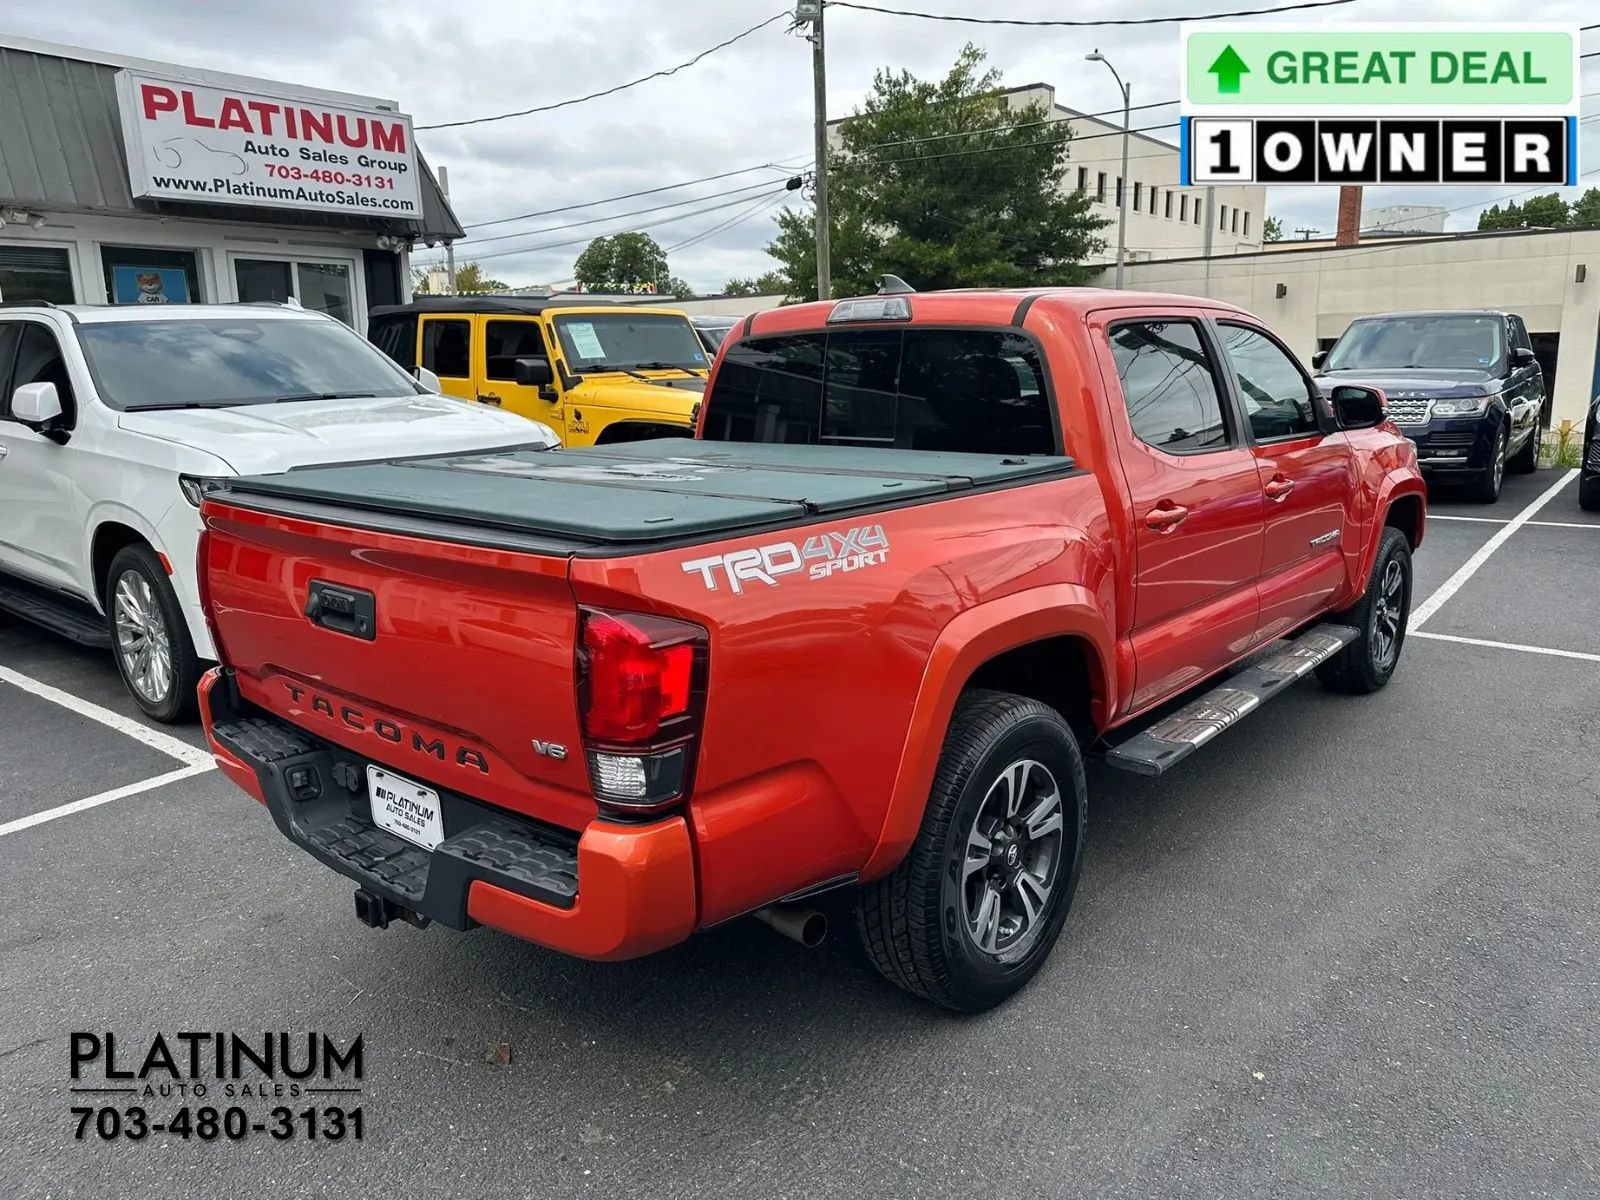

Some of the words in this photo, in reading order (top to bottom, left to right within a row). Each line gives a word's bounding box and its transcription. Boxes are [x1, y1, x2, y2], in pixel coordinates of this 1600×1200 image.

[140, 84, 406, 154] PLATINUM
[243, 140, 290, 158] Auto
[299, 147, 349, 166] Sales
[357, 155, 408, 174] Group
[264, 163, 395, 190] 703-480-3131
[152, 175, 414, 212] www.PlatinumAutoSales.com
[681, 541, 805, 596] TRD
[809, 548, 890, 581] SPORT
[284, 682, 489, 775] TACOMA
[531, 738, 569, 761] V6
[386, 804, 403, 817] AUTO
[404, 812, 425, 828] SALES
[387, 791, 434, 821] PLATINUM
